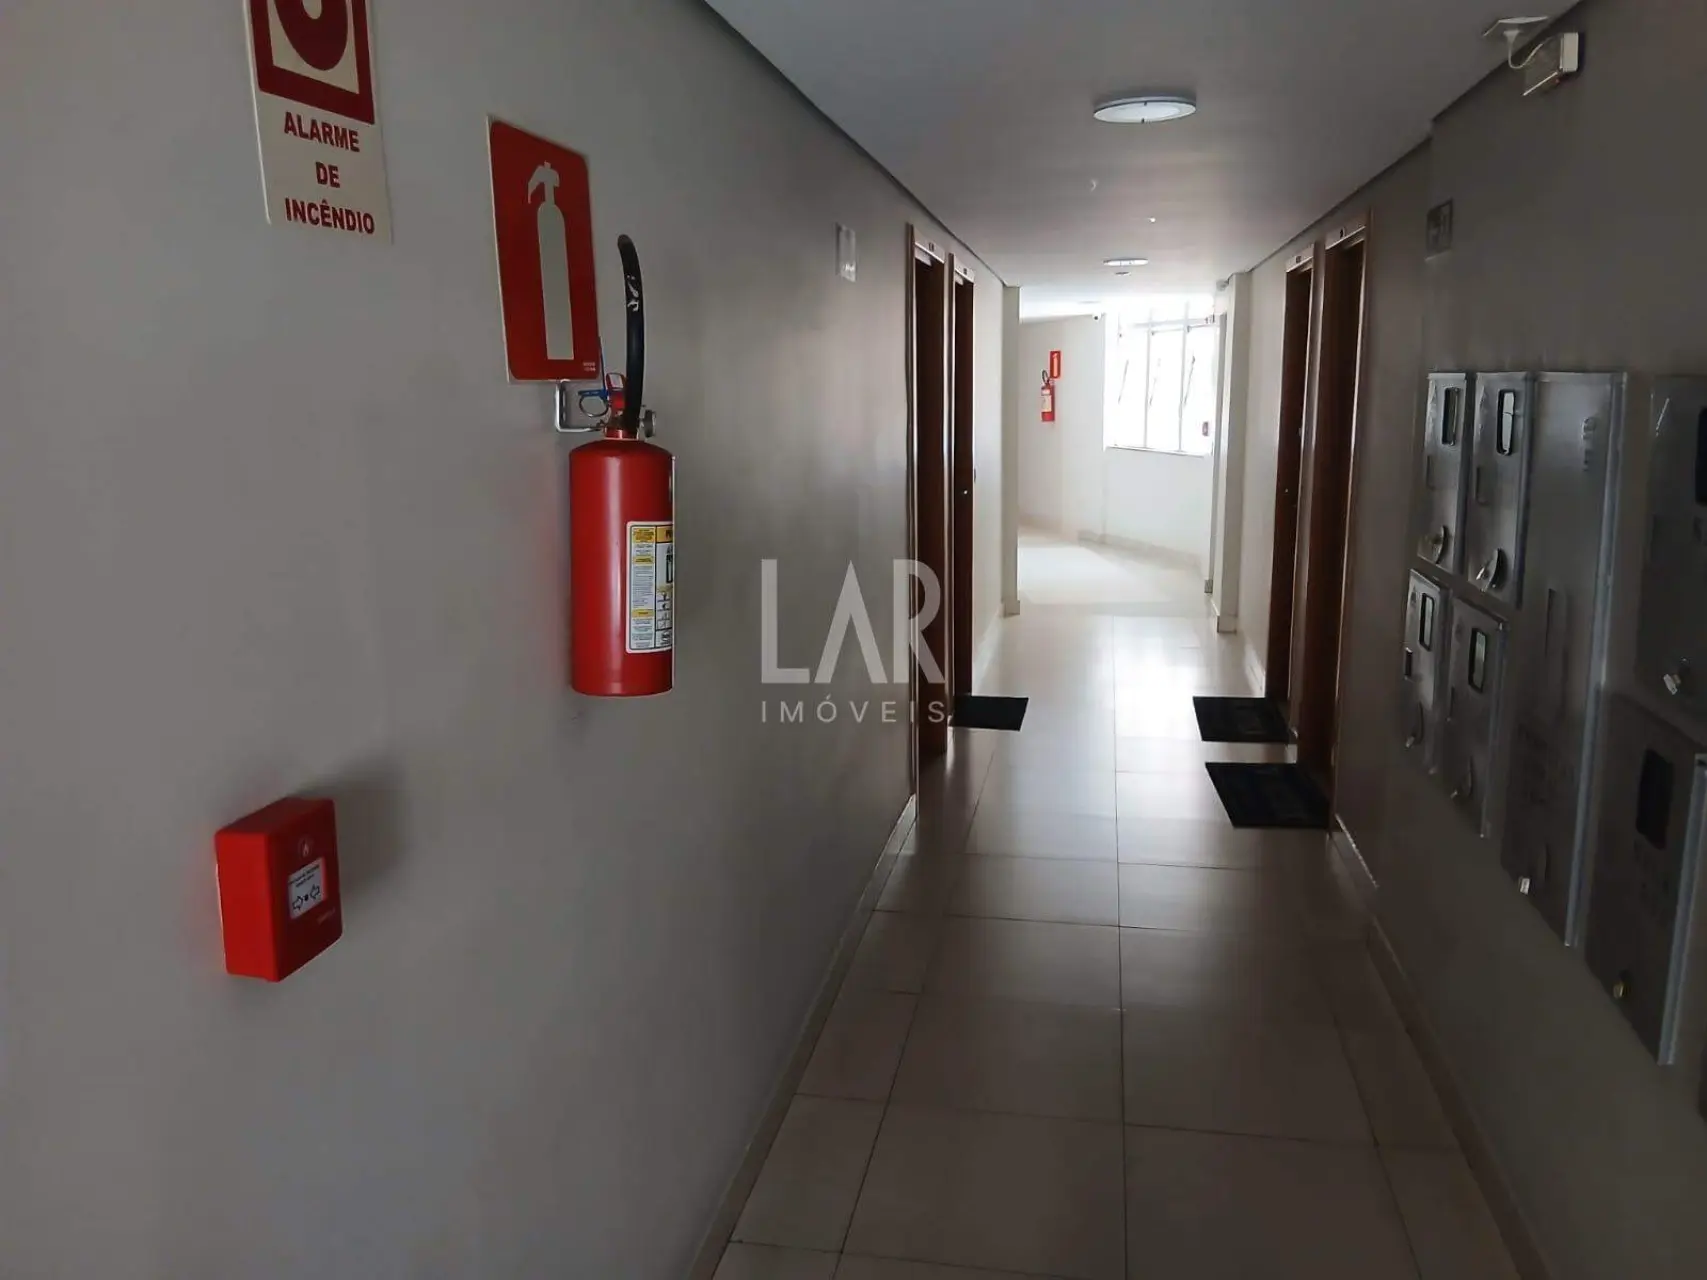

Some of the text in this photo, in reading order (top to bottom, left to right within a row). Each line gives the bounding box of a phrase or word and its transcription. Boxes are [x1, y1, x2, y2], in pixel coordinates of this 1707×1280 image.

[284, 111, 360, 152] ALARME
[315, 161, 341, 188] DE
[284, 197, 375, 234] INCÊNDIO
